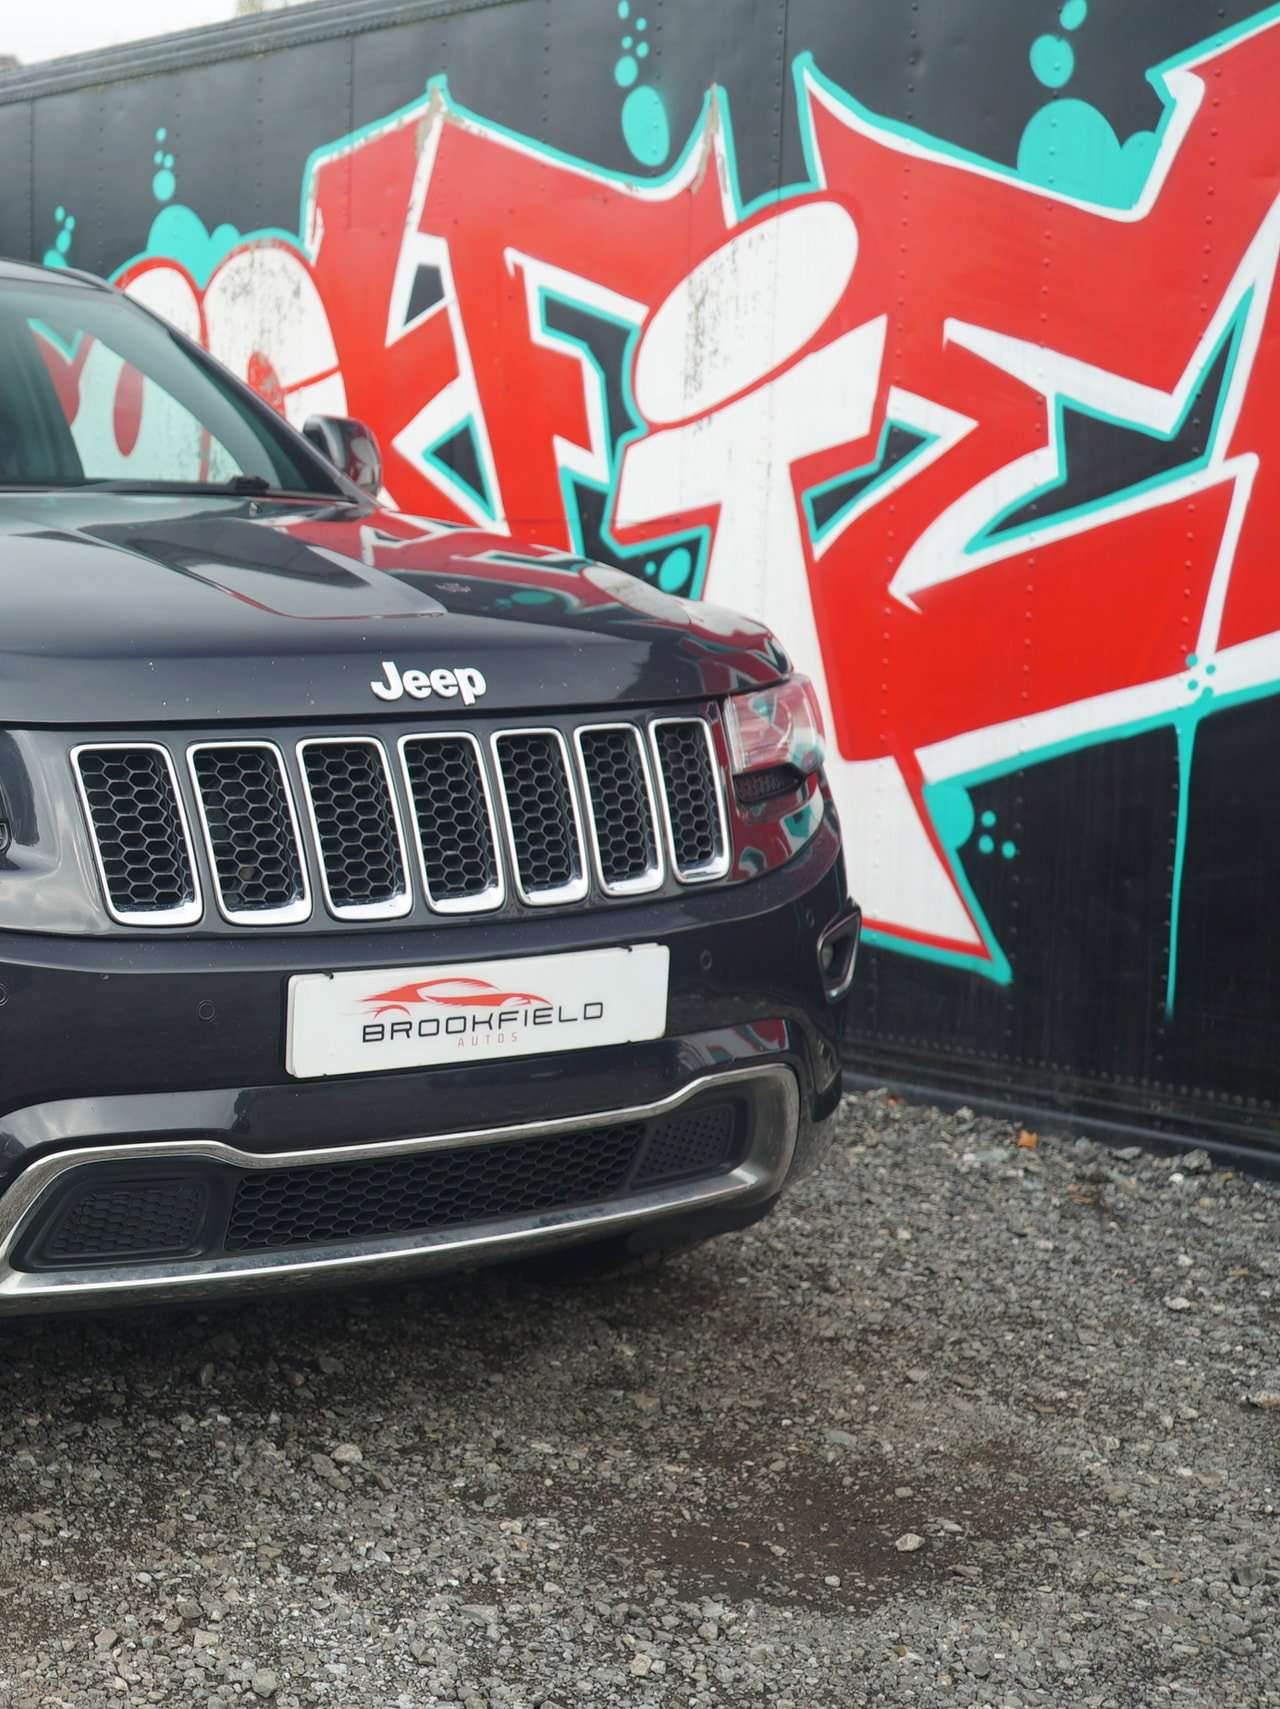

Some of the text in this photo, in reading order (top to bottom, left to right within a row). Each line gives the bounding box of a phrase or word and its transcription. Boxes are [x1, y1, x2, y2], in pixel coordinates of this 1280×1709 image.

[370, 660, 487, 706] Jeep
[362, 1001, 604, 1043] BROOKFIELD
[457, 1031, 518, 1048] AUTOS
